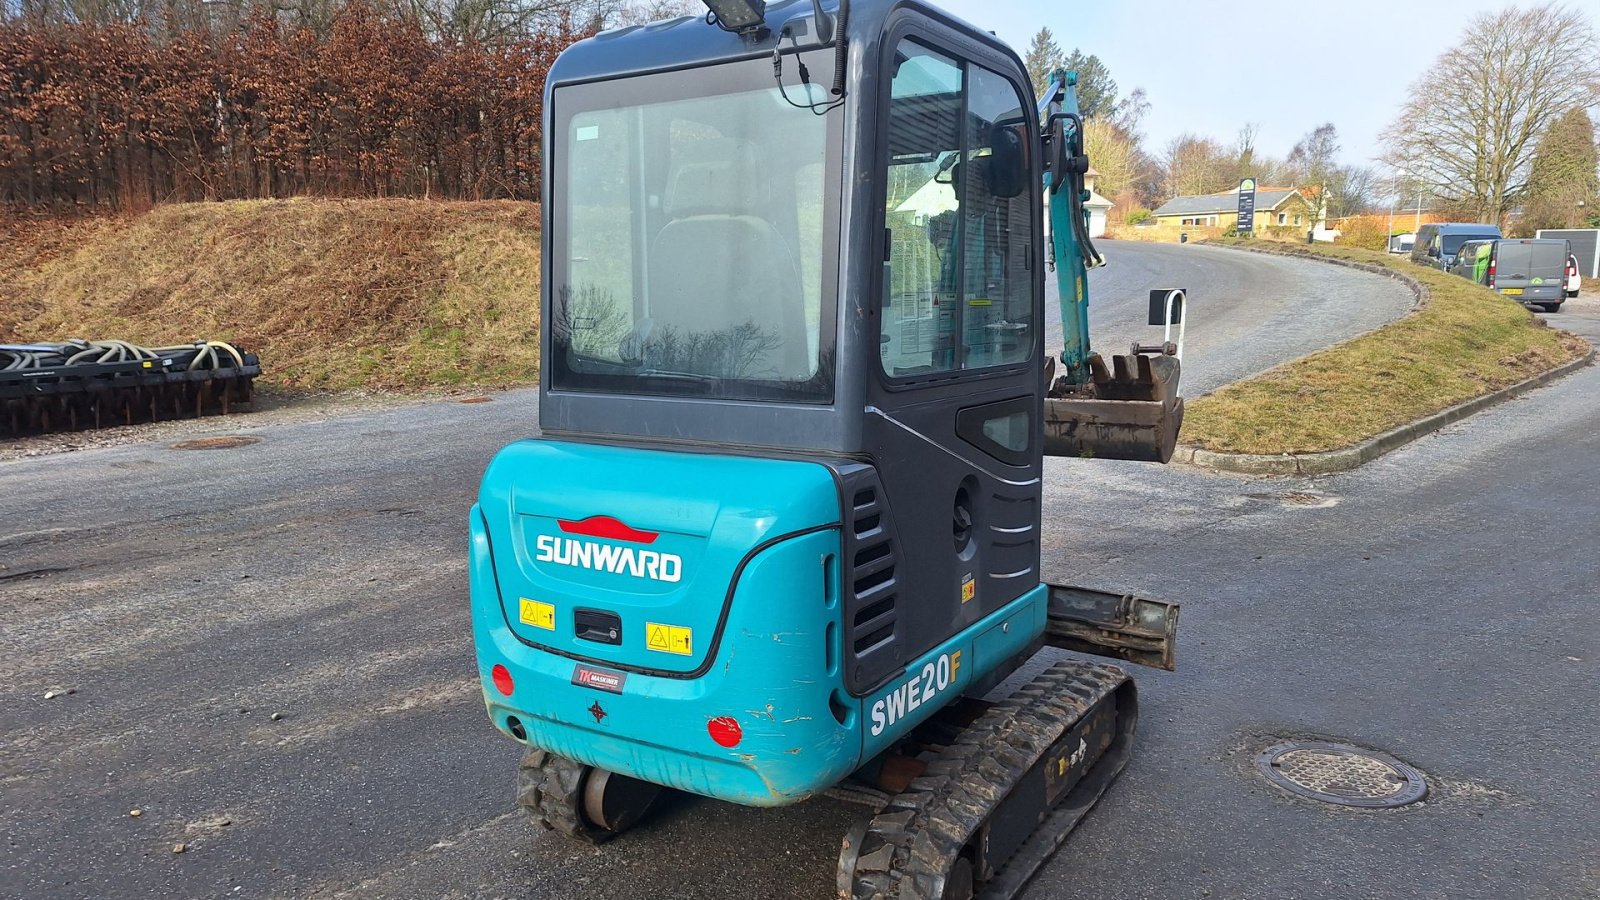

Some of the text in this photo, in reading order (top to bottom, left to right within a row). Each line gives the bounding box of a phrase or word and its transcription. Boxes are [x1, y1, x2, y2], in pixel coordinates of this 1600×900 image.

[536, 534, 682, 583] SUNWARD
[579, 669, 592, 683] TK
[871, 650, 961, 736] SWE20F
